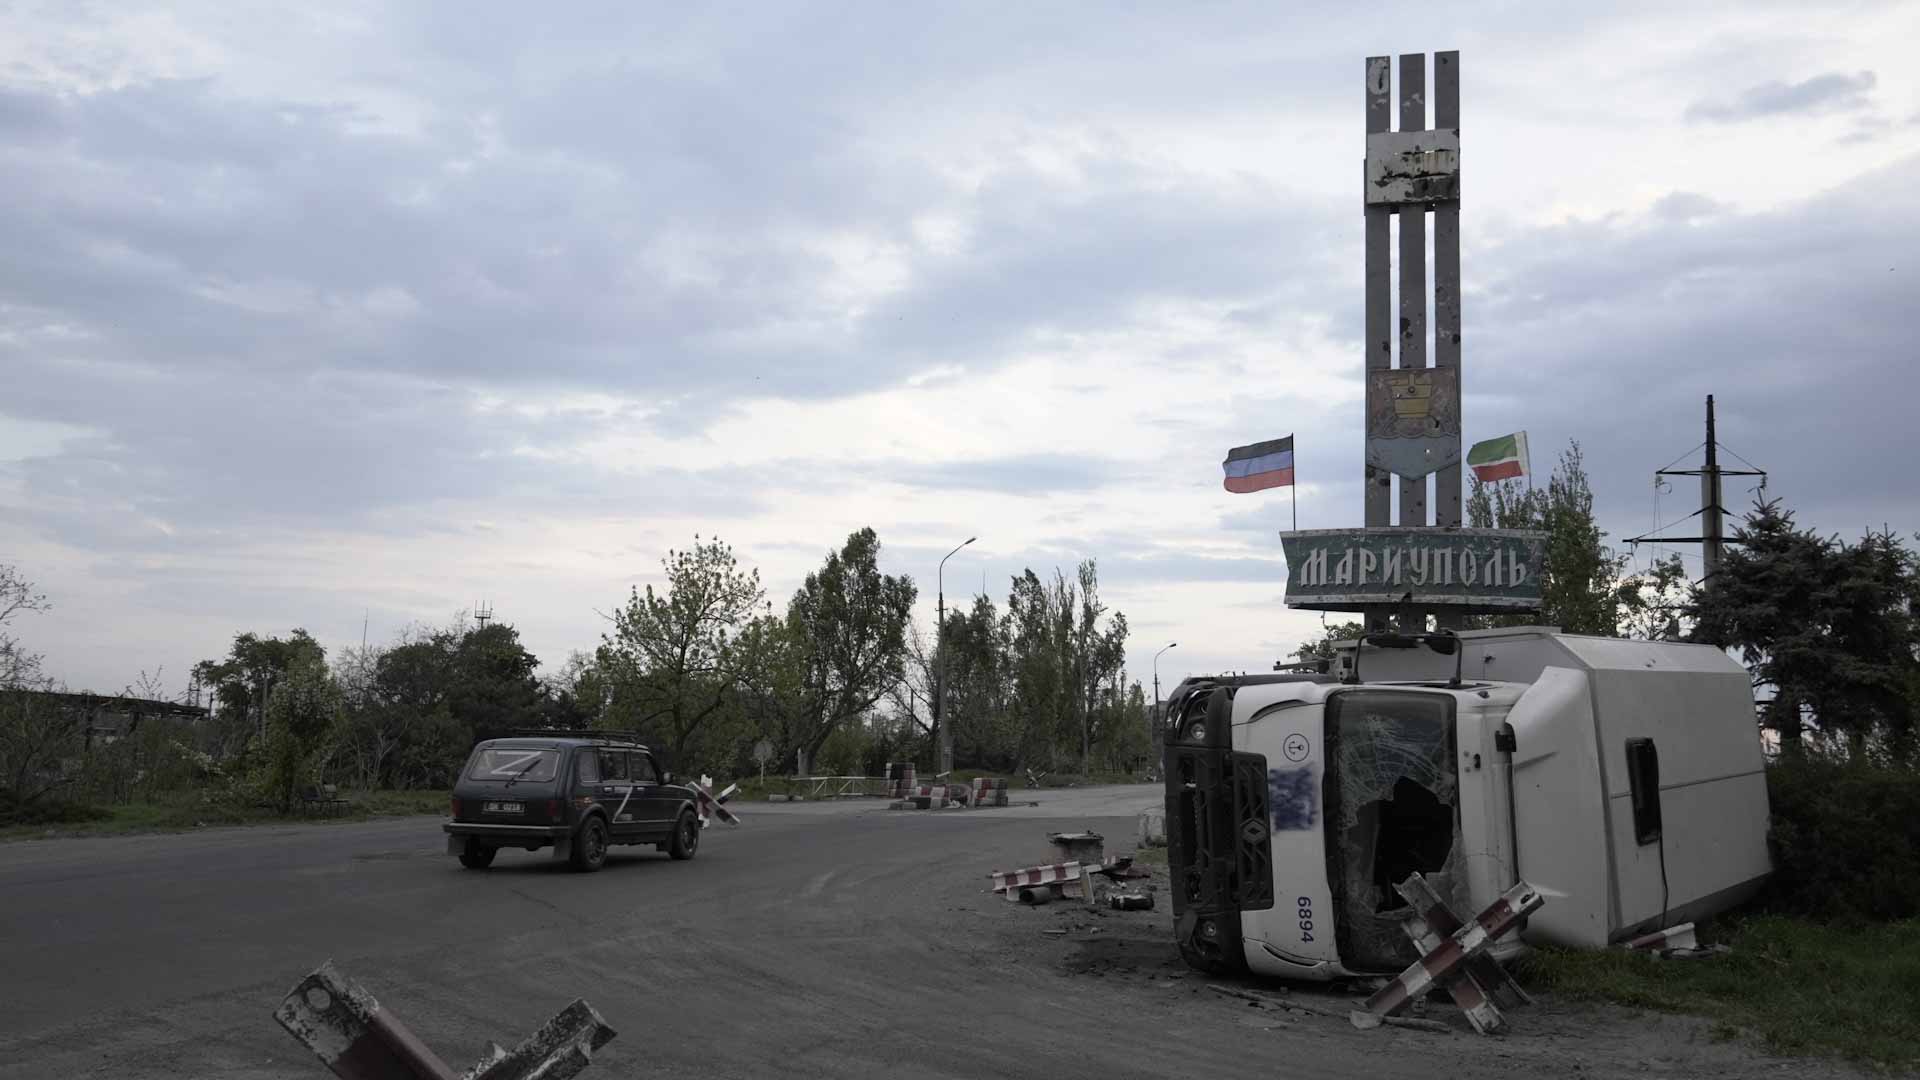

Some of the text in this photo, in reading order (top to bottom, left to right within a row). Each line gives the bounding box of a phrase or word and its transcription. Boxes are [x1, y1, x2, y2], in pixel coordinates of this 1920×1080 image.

[1300, 546, 1527, 588] МАРИУПОЛЬ
[490, 751, 542, 776] Z
[1297, 896, 1314, 943] 6894
